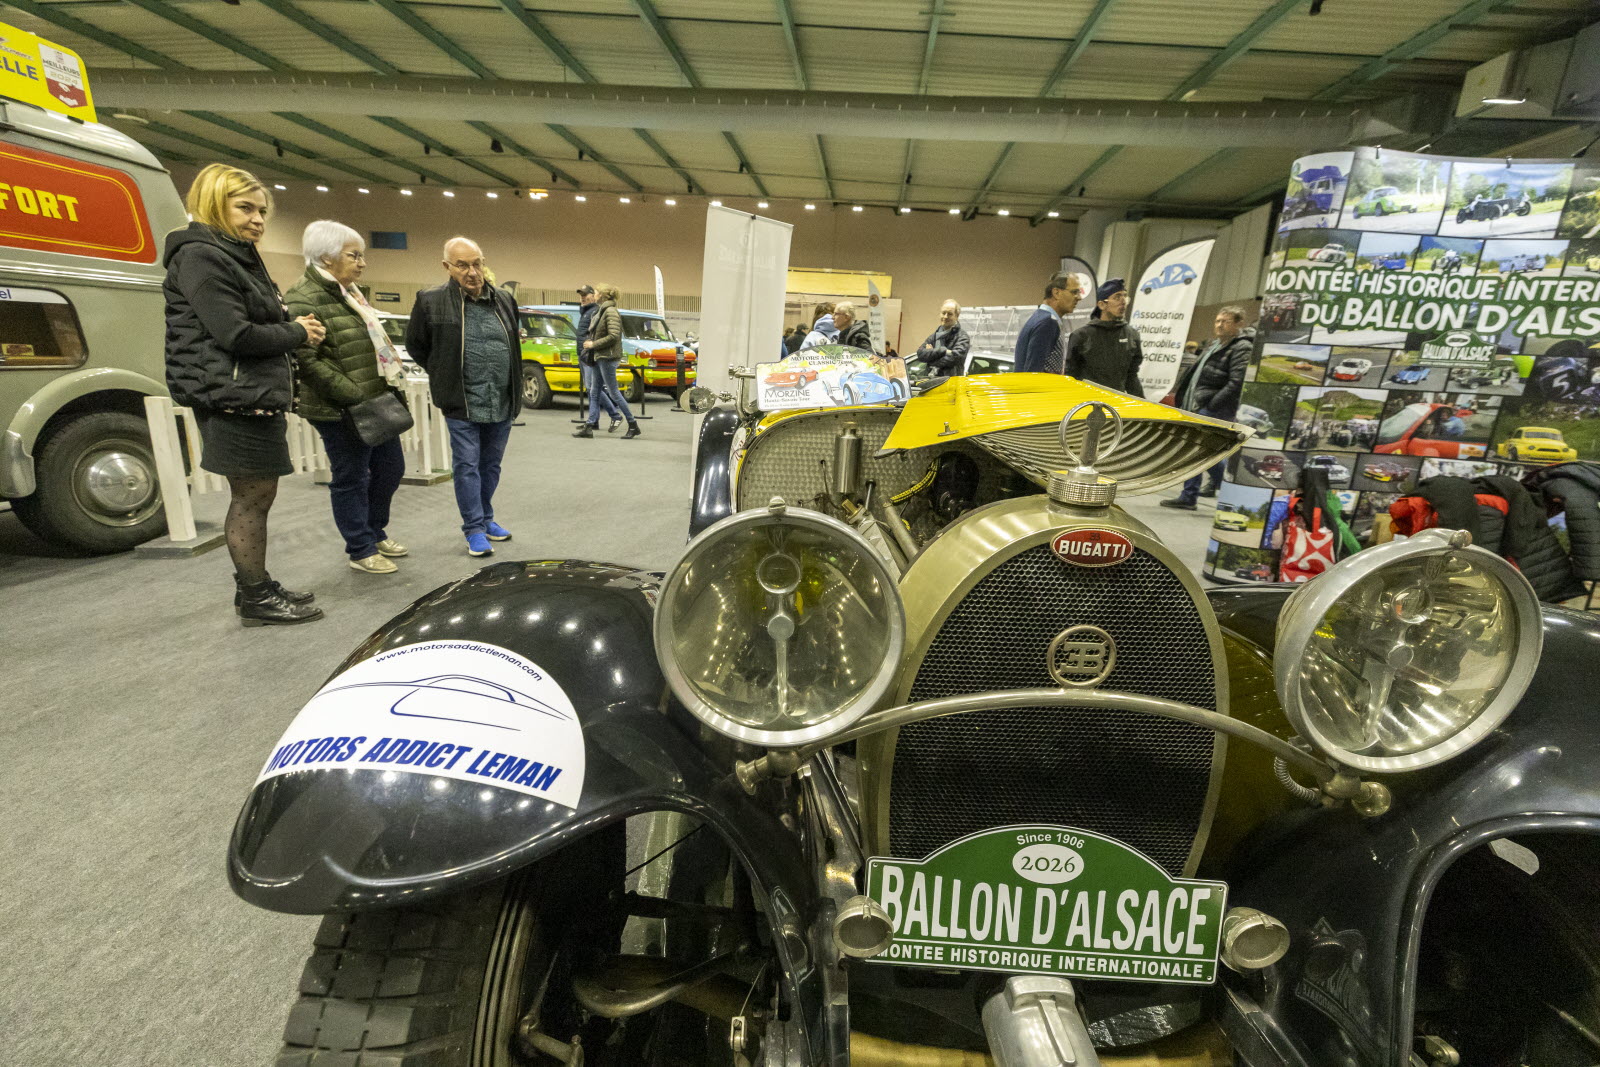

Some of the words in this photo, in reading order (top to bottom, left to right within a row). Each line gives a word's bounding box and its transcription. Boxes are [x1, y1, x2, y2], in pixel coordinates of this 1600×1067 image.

[0, 56, 38, 81] LLE
[1133, 310, 1185, 321] Association
[1301, 303, 1339, 325] DU
[1341, 297, 1468, 331] BALLON
[764, 388, 811, 399] MORZINE
[1058, 539, 1127, 559] BUGATTI
[376, 643, 543, 682] www.motorsaddictleman.com
[263, 736, 367, 776] MOTORS
[360, 737, 473, 770] ADDICT
[466, 749, 563, 792] LEMAN
[1016, 833, 1052, 846] Since
[1056, 832, 1085, 849] 1906
[1020, 855, 1076, 873] 2026
[880, 864, 1023, 944] BALLON
[1031, 887, 1211, 955] D'ALSACE
[950, 947, 1052, 969] HISTORIQUE
[1058, 955, 1204, 978] INTERNATIONALE
